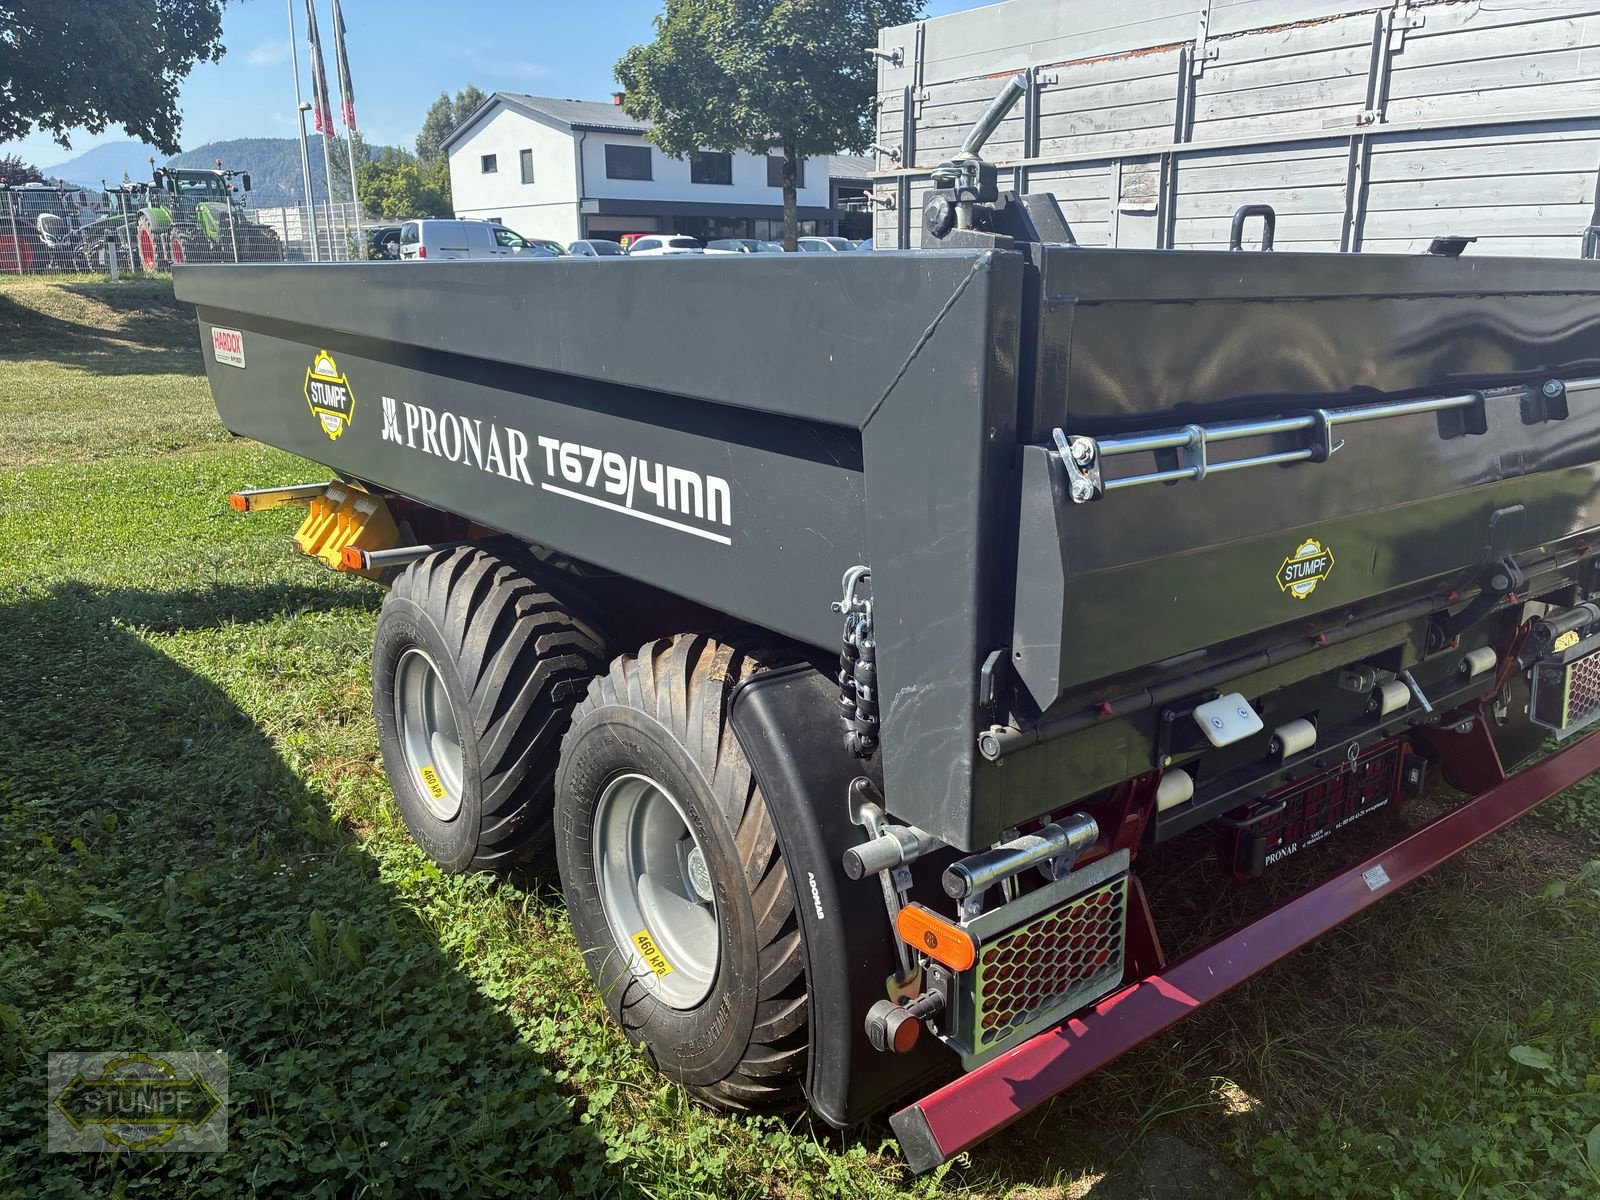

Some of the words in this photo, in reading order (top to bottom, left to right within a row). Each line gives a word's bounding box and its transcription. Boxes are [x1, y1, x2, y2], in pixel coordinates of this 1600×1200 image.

[214, 331, 241, 354] HARDOX
[310, 381, 346, 409] STUMPF
[403, 402, 534, 486] PRONAR
[1285, 557, 1327, 581] STUMPF
[424, 770, 437, 784] 460
[431, 784, 442, 798] kPa
[1265, 842, 1297, 867] PRONAR
[638, 936, 655, 956] 460
[650, 955, 666, 974] kPa
